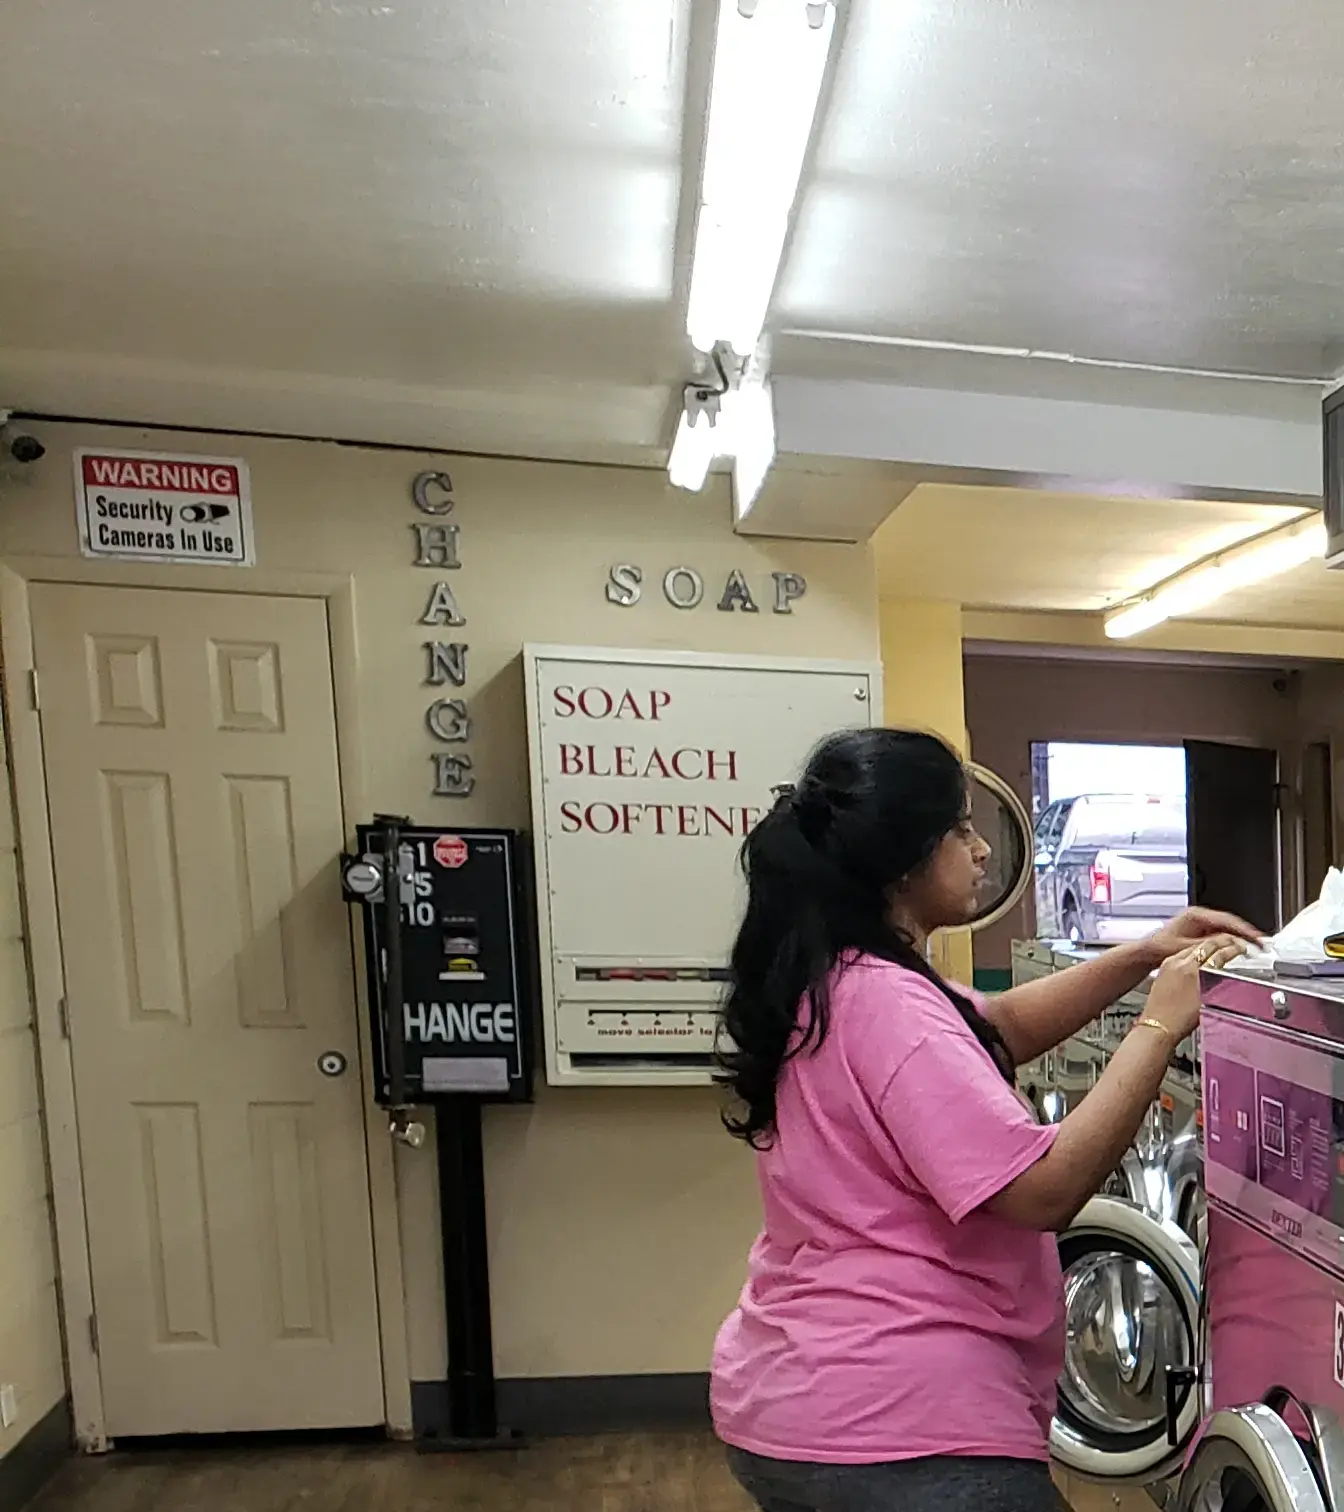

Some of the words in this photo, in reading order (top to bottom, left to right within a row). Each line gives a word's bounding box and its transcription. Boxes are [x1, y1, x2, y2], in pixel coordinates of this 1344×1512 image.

[92, 459, 233, 493] WARNING
[96, 495, 173, 526] Security
[98, 523, 175, 550] Cameras
[181, 528, 197, 551] In
[203, 529, 234, 553] Use
[605, 564, 807, 615] SOAP
[411, 470, 476, 797] CHANGE
[553, 685, 672, 721] SOAP
[559, 743, 738, 781] BLEACH
[560, 800, 772, 838] SOFTENE
[403, 1002, 516, 1042] HANGE
